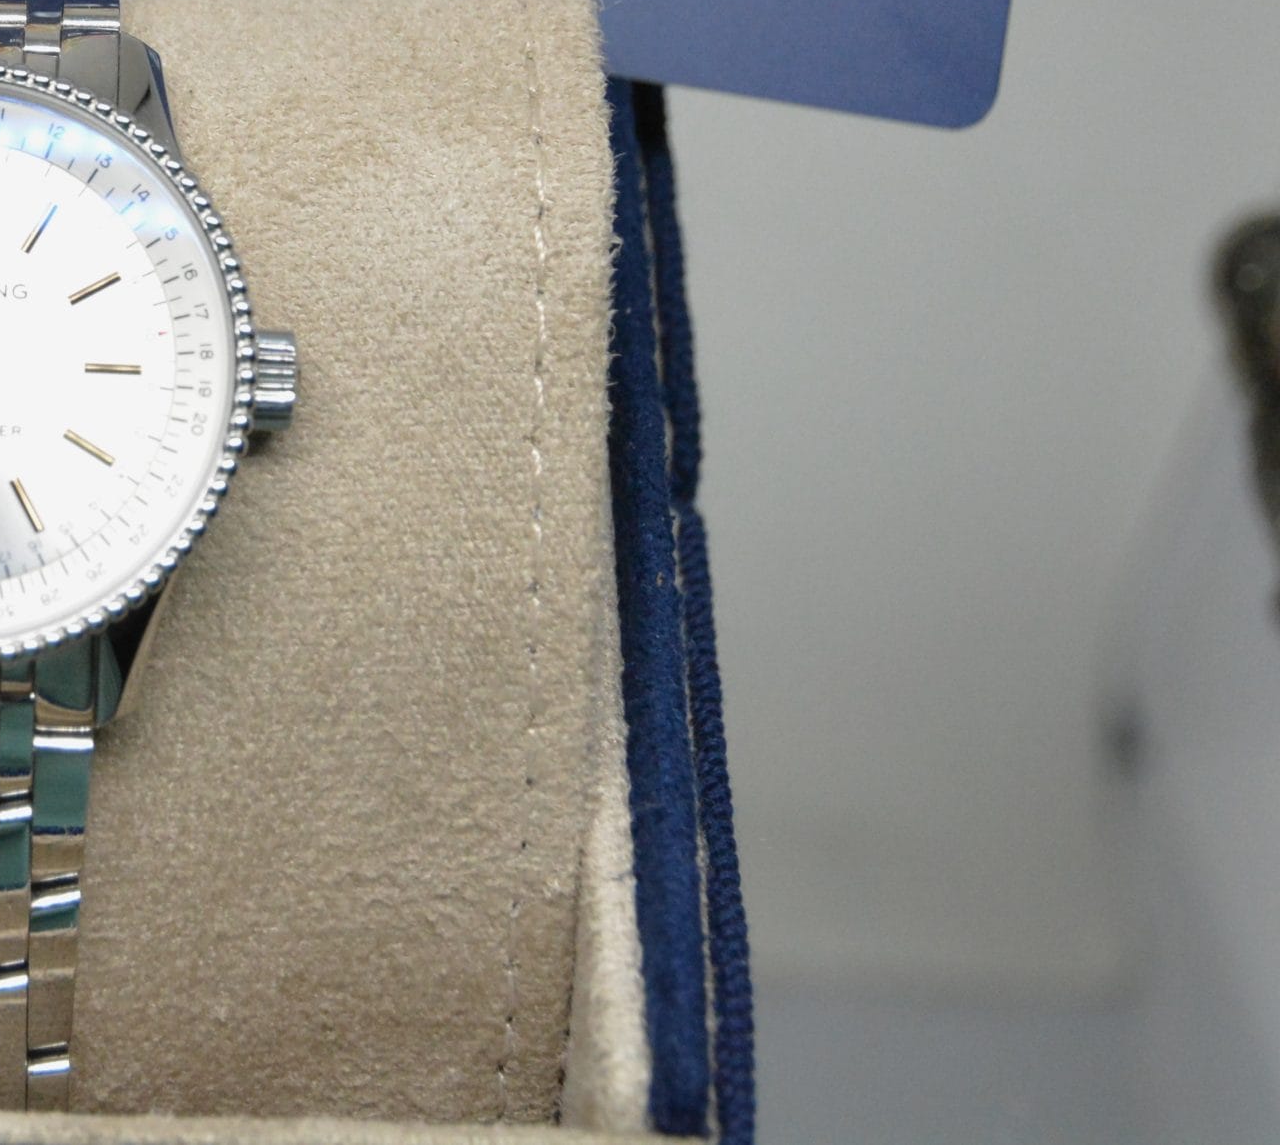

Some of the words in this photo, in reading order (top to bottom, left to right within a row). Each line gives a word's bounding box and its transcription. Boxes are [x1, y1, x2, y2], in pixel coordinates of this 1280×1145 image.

[48, 123, 66, 140] 12
[95, 153, 113, 169] 13
[131, 183, 151, 203] 14
[181, 262, 199, 281] 16
[193, 303, 210, 320] 17
[199, 343, 215, 360] 18
[198, 380, 213, 398] 19
[190, 411, 208, 437] 20
